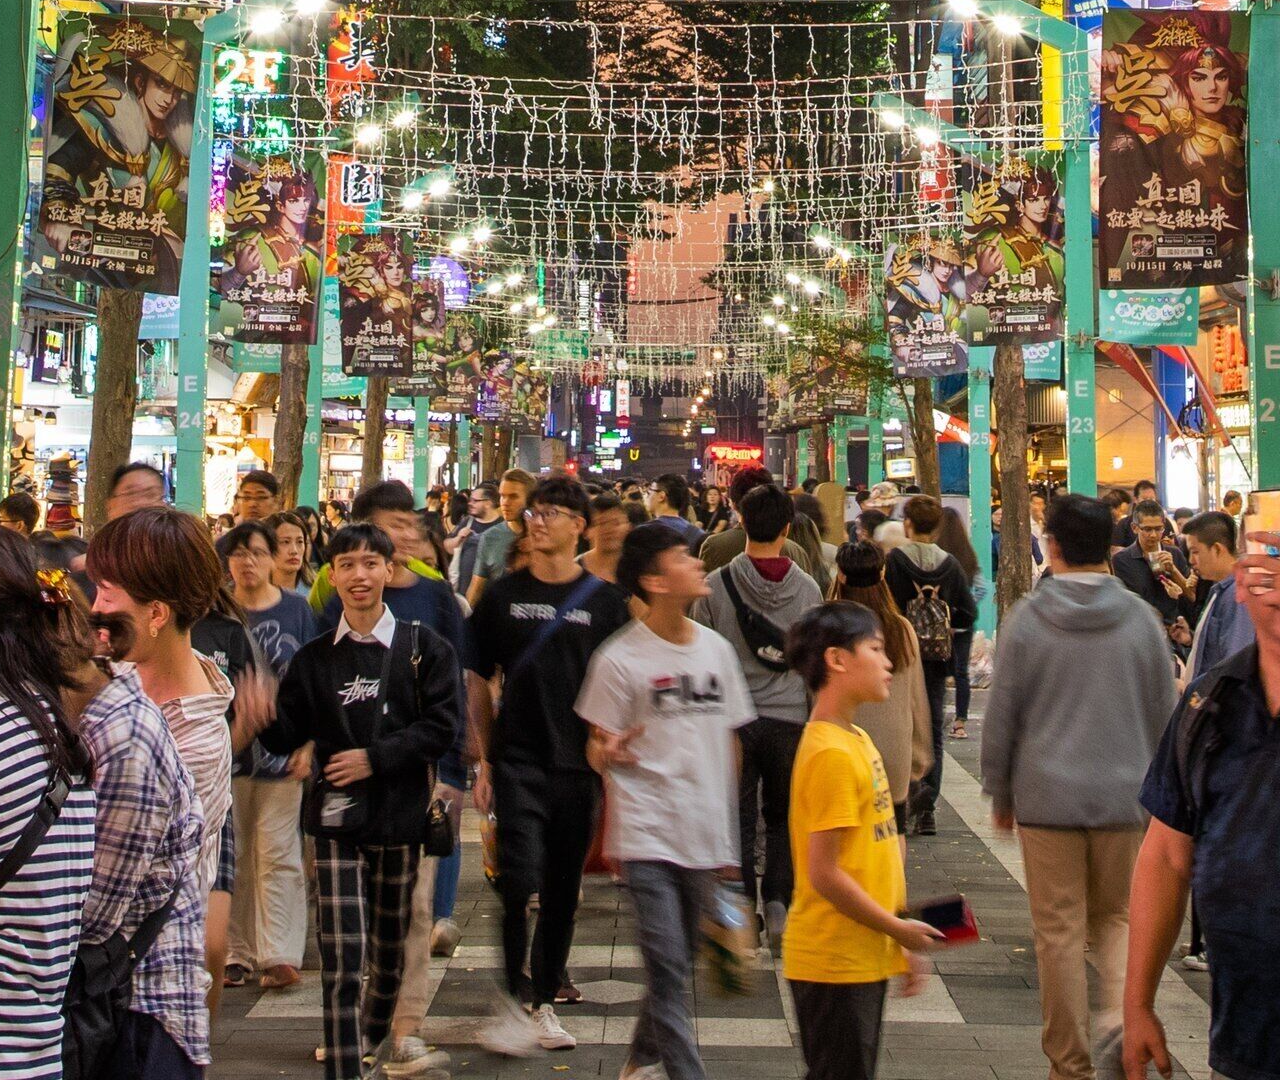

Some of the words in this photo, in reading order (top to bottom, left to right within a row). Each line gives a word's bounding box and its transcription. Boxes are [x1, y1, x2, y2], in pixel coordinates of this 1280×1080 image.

[214, 48, 285, 98] 2F
[80, 172, 147, 209] 真三國
[1135, 171, 1201, 209] 真三國
[1105, 203, 1235, 232] 就要一起殺出來
[60, 253, 100, 268] 10月15日
[1125, 261, 1167, 271] 10月15日
[246, 264, 293, 288] 真三國
[990, 264, 1037, 290] 真三國
[183, 375, 198, 393] E
[1074, 380, 1089, 398] E
[306, 403, 315, 417] E
[974, 403, 985, 418] E
[178, 411, 202, 430] 24
[1070, 416, 1095, 434] 23
[302, 431, 318, 445] 26
[416, 428, 425, 439] E
[872, 433, 880, 444] E
[970, 431, 989, 446] 25
[414, 447, 427, 457] 30
[870, 451, 883, 462] 27
[651, 673, 724, 708] FILA
